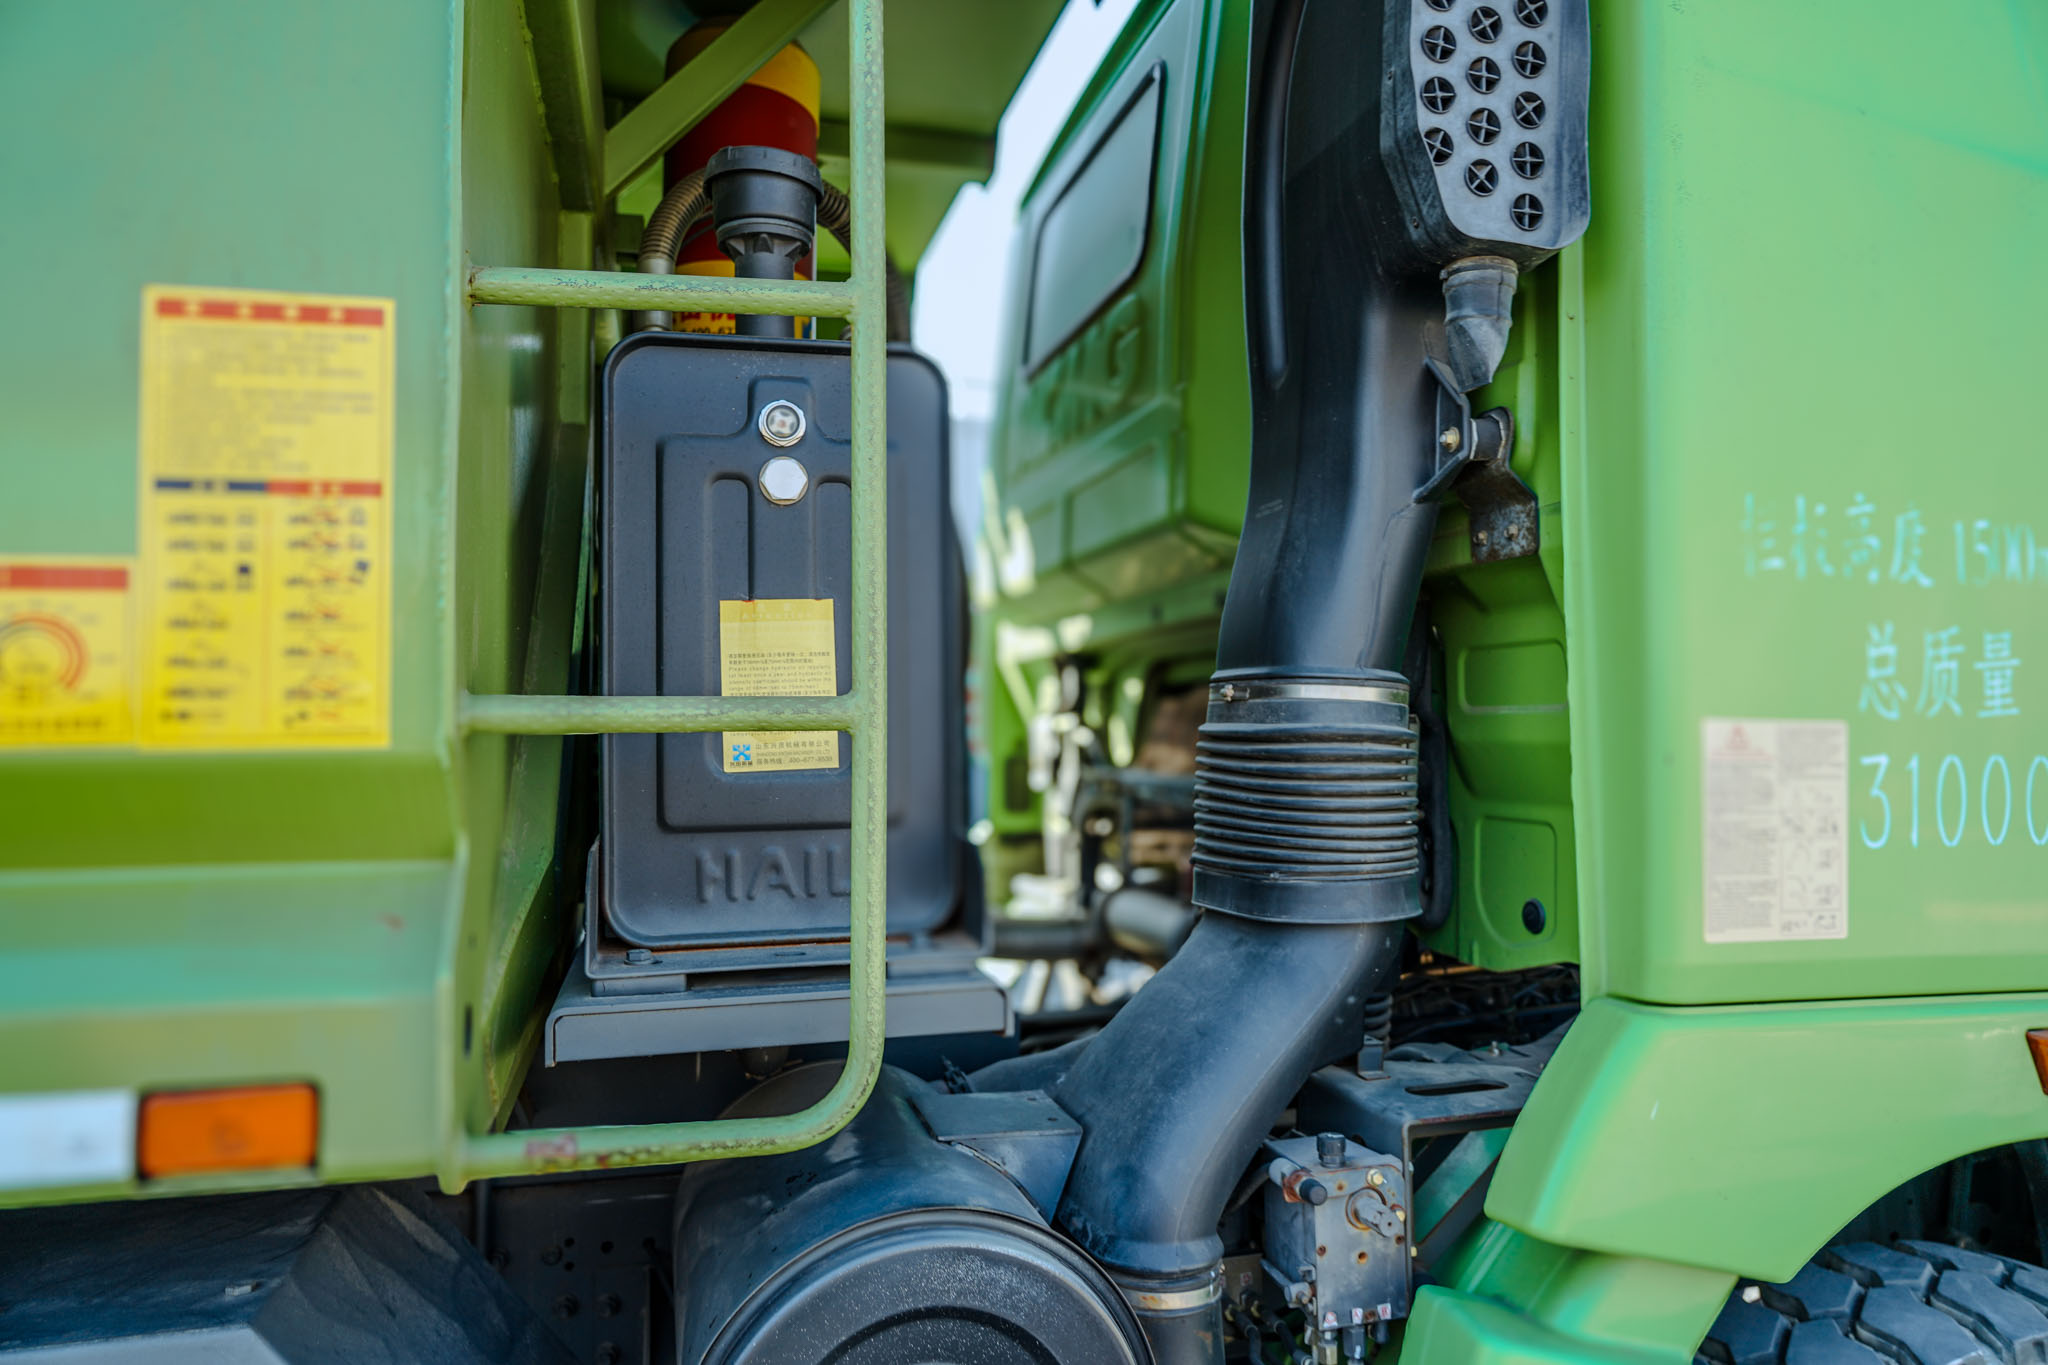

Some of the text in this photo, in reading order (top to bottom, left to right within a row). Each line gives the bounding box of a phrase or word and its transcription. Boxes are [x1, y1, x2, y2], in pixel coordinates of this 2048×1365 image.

[1857, 620, 2022, 721] 总质量
[1859, 752, 2048, 850] 31000
